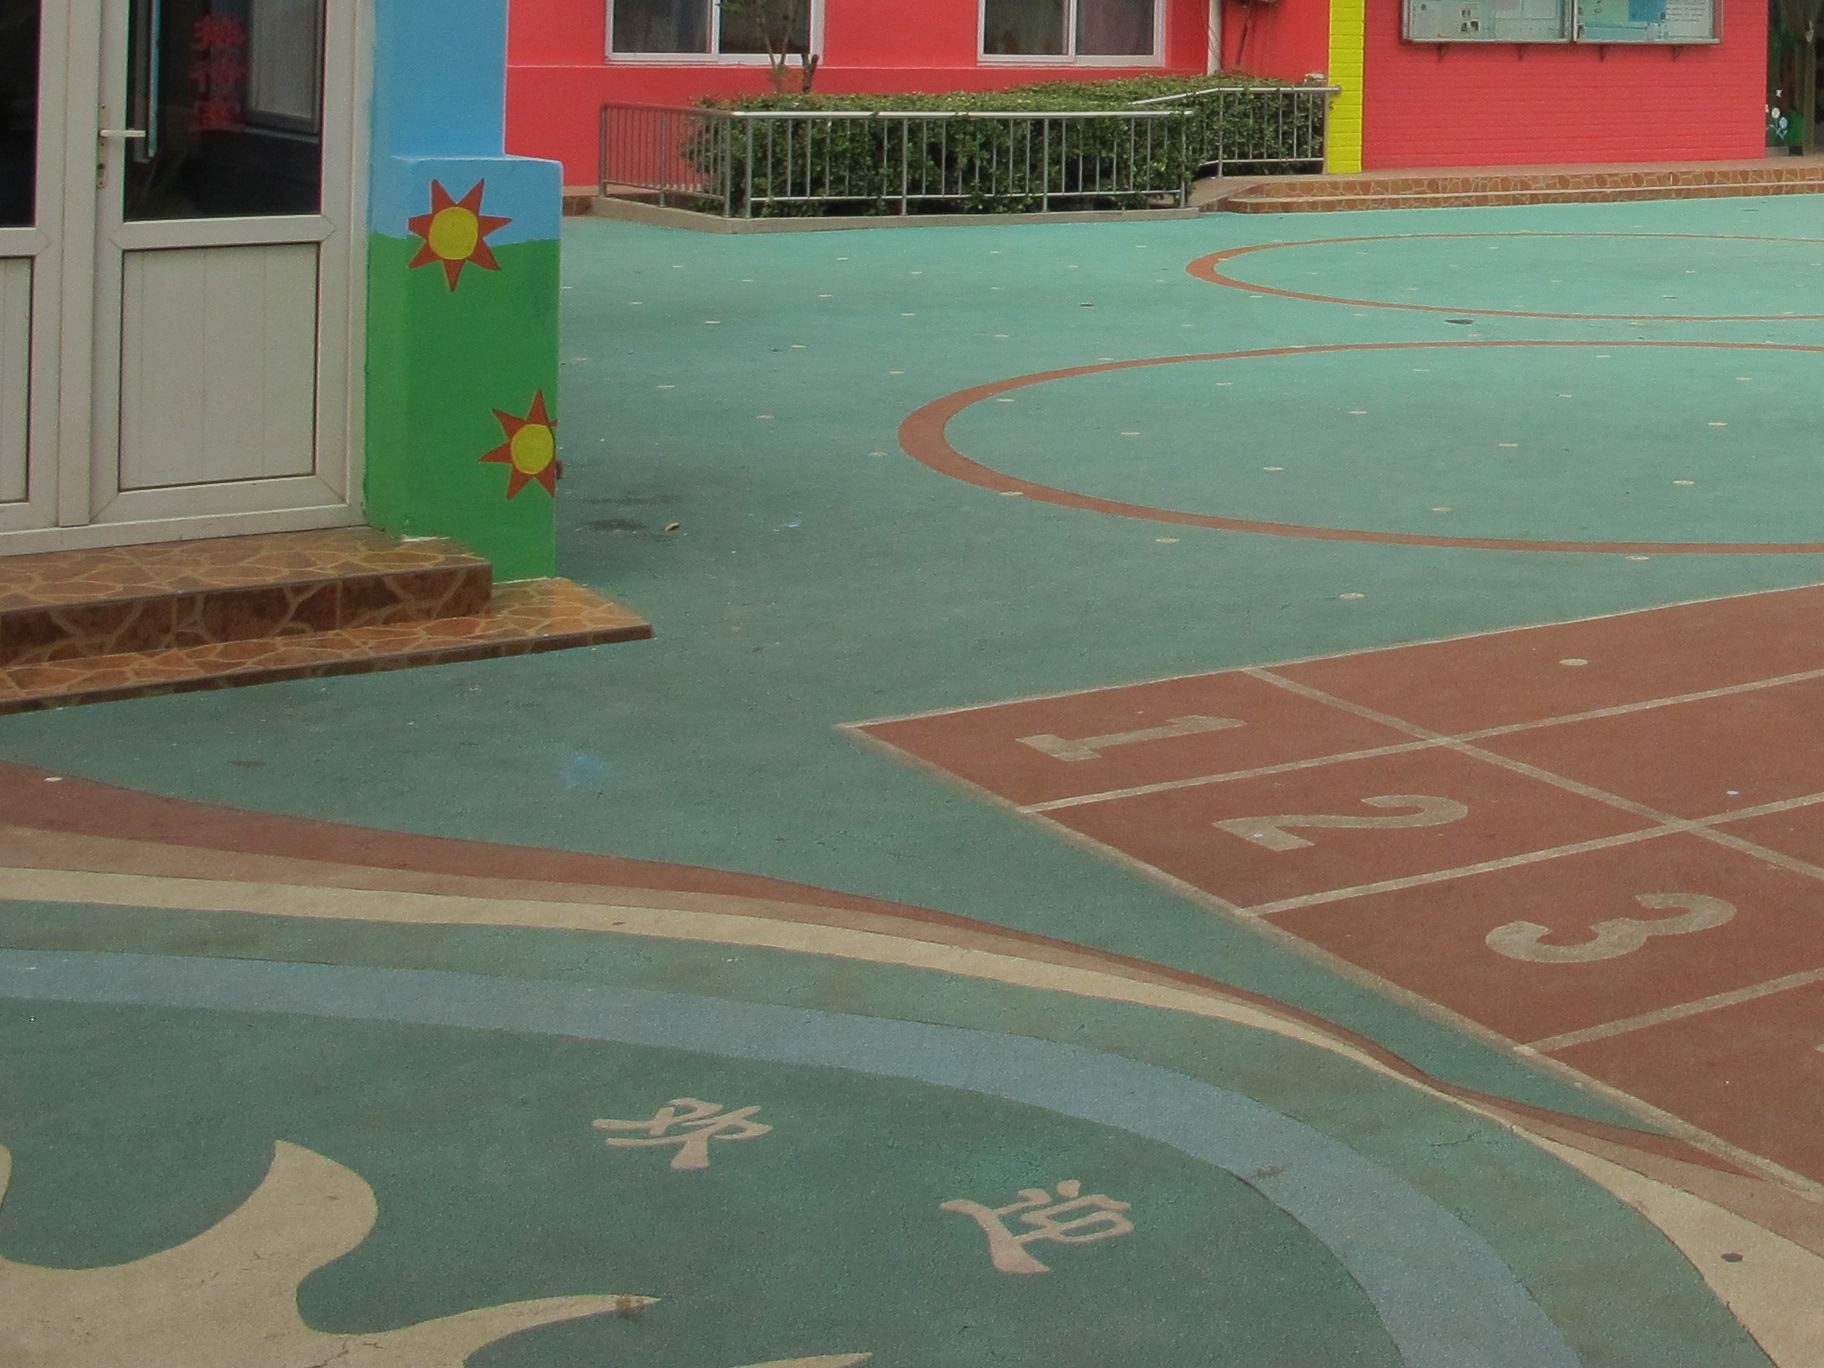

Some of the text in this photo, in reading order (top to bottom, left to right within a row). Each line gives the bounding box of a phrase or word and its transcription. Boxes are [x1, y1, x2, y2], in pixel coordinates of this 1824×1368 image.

[1015, 715, 1248, 763] 1
[1211, 795, 1469, 852] 2
[1484, 892, 1739, 965] 3
